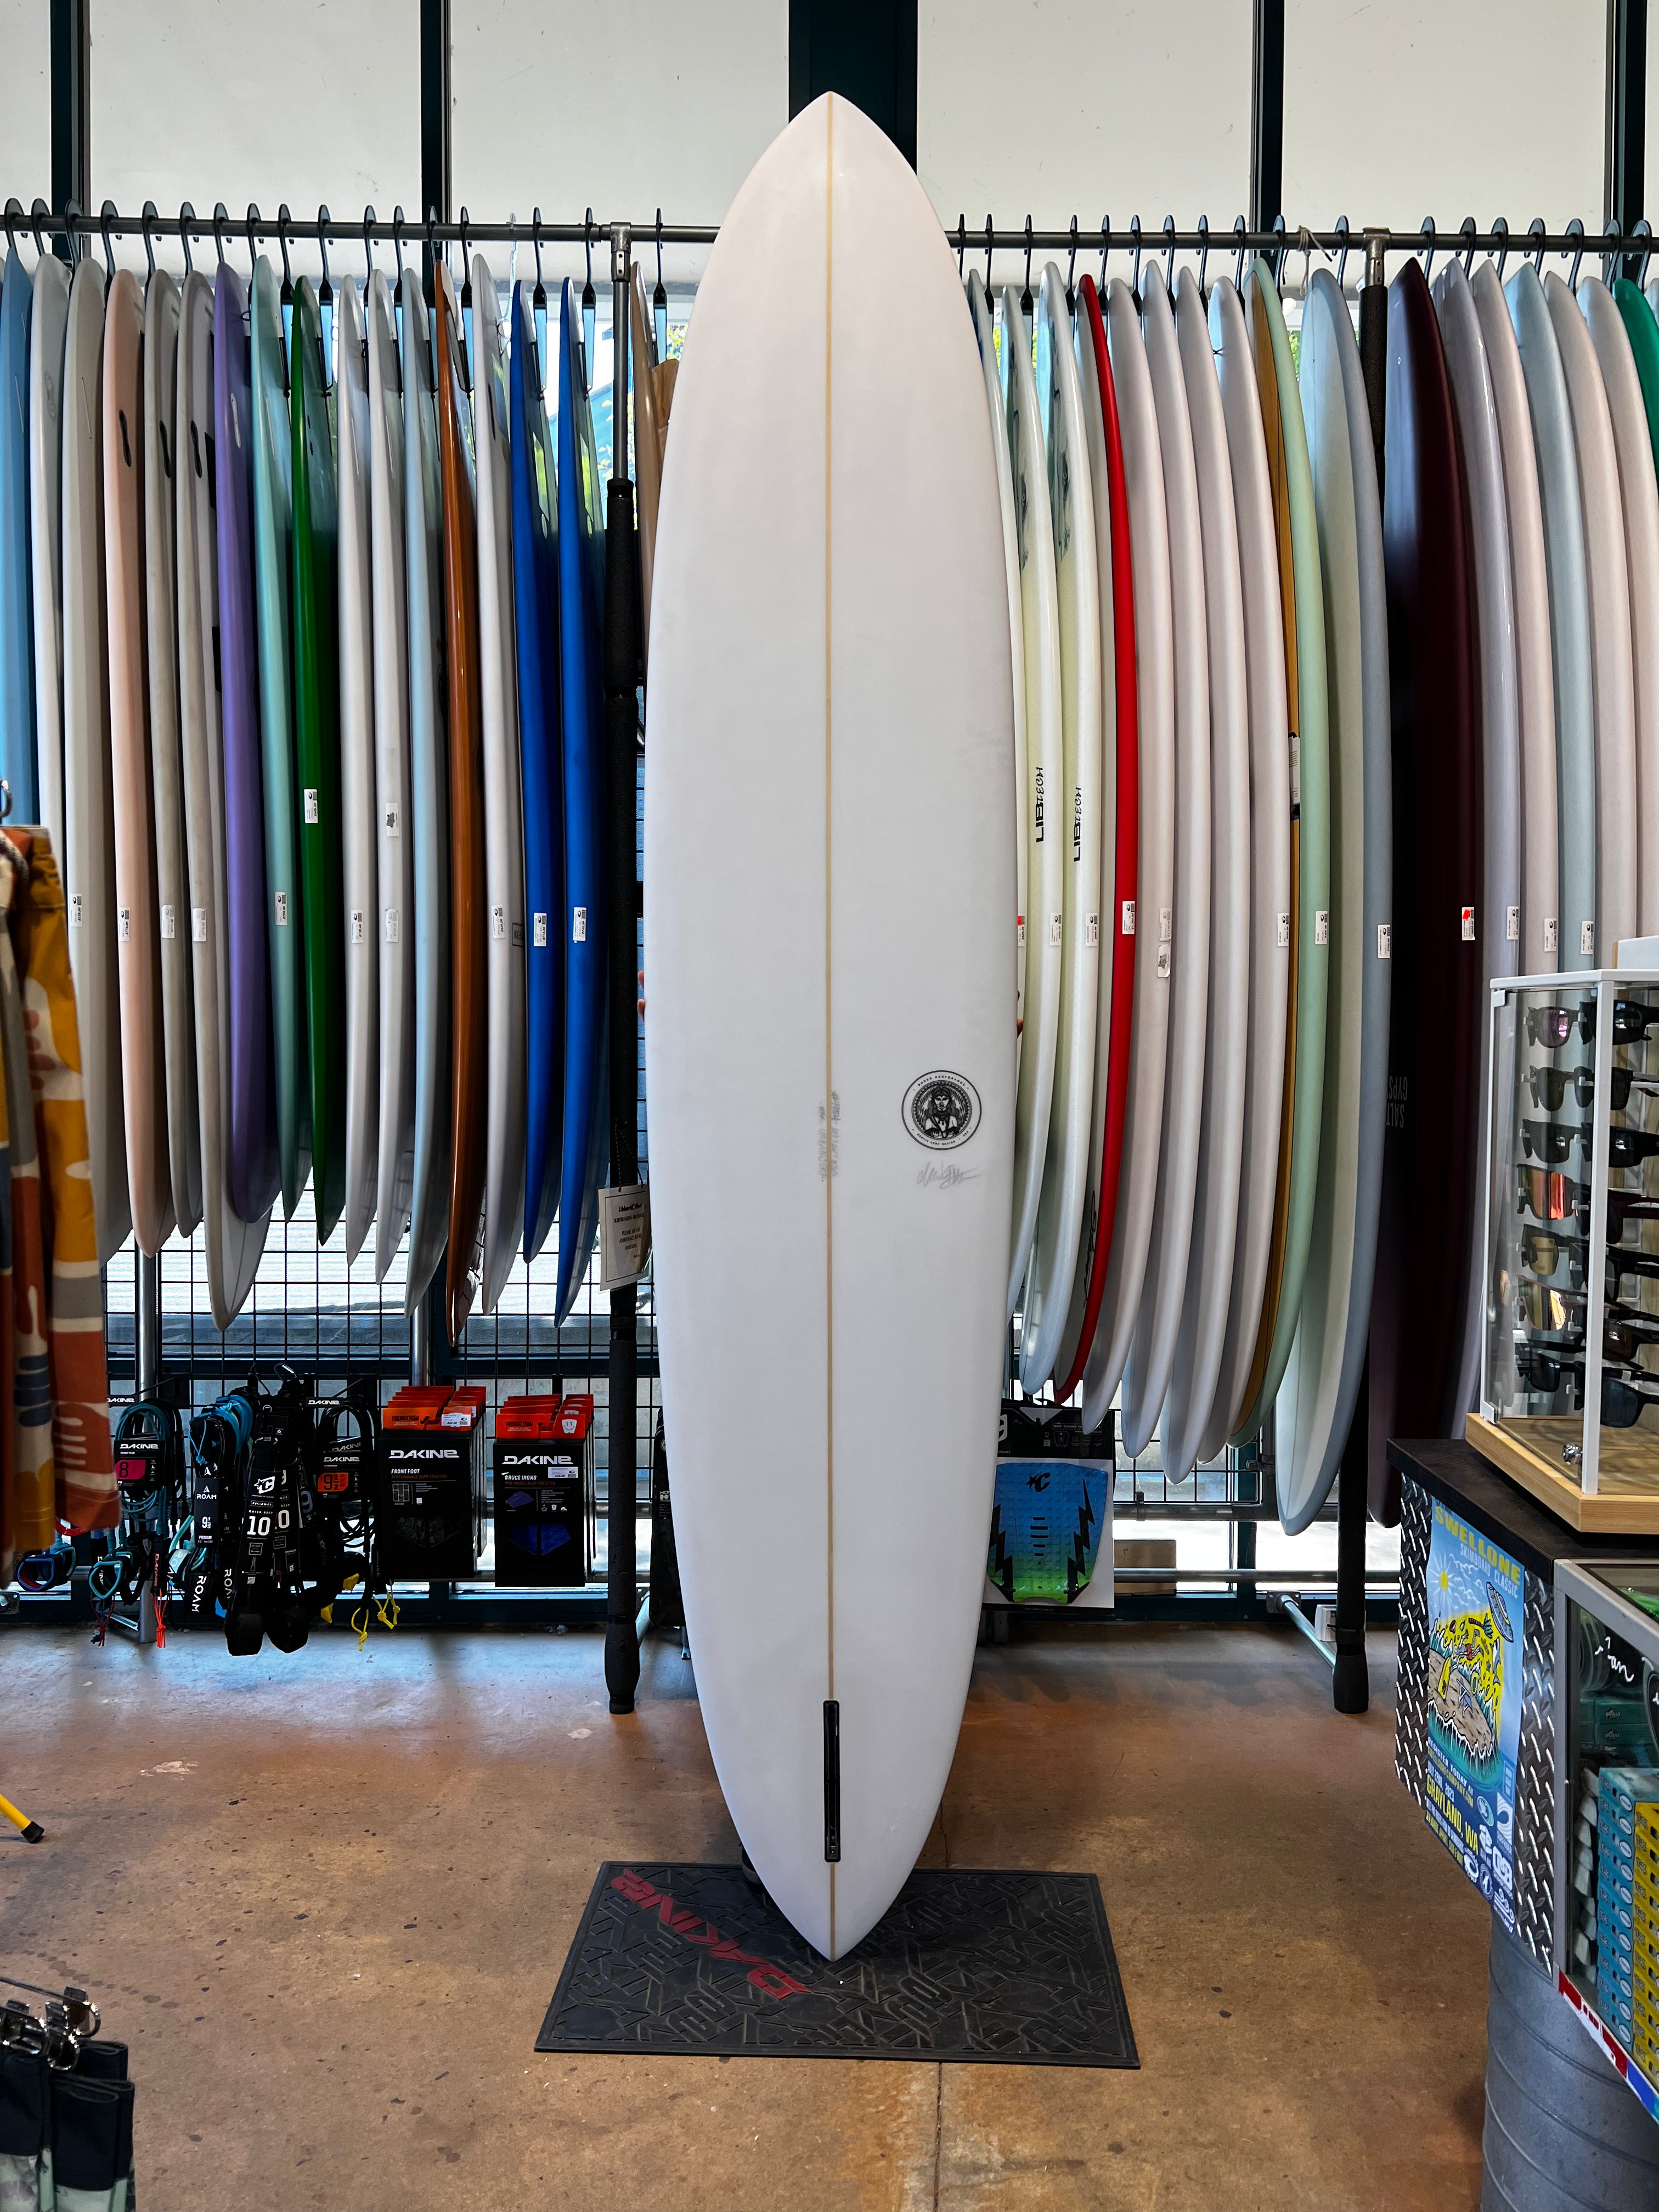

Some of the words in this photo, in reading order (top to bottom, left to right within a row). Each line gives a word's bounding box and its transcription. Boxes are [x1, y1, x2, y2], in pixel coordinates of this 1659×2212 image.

[1386, 1075, 1408, 1101] GYPS
[1385, 1102, 1404, 1128] SALT
[388, 1449, 460, 1459] DAKINE
[501, 1455, 574, 1465] DAKINE
[119, 1461, 129, 1478] 8
[323, 1474, 333, 1491] 9
[247, 1515, 271, 1536] 10
[1460, 1543, 1492, 1577] SKIMBOARD
[1494, 1569, 1519, 1599] CLASSIC
[191, 1575, 207, 1613] ROAM
[1427, 1736, 1449, 1768] REGISTER
[1449, 1763, 1468, 1787] TODAY
[1468, 1785, 1474, 1796] AT
[1426, 1773, 1464, 1838] GRAYLAND,
[1465, 1820, 1479, 1856] WA
[610, 1869, 811, 2000] DAKINE
